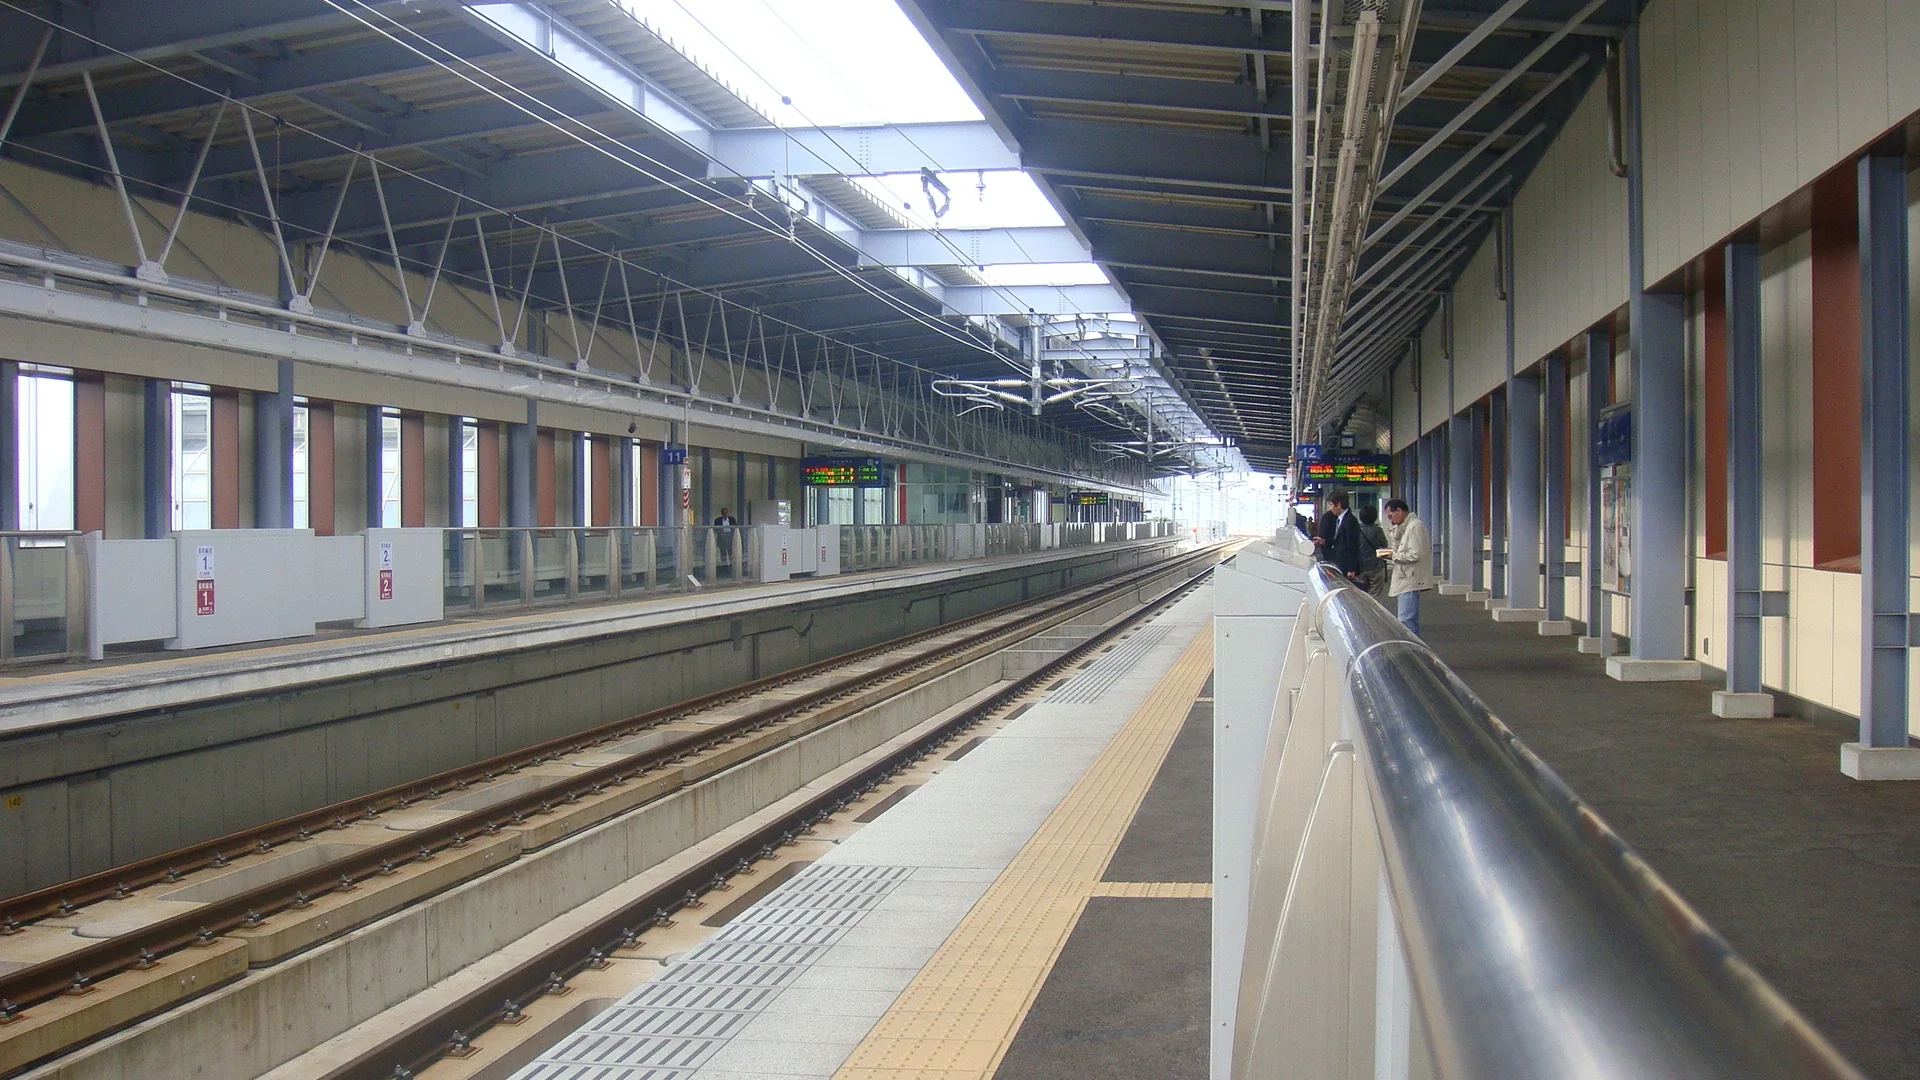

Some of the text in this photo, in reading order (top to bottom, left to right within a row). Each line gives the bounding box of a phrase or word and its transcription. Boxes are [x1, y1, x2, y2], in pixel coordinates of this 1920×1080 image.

[667, 451, 680, 462] 11
[1302, 447, 1317, 458] 12
[383, 550, 389, 562] 2
[203, 555, 208, 570] 1
[383, 579, 389, 592] 2
[203, 591, 208, 606] 1
